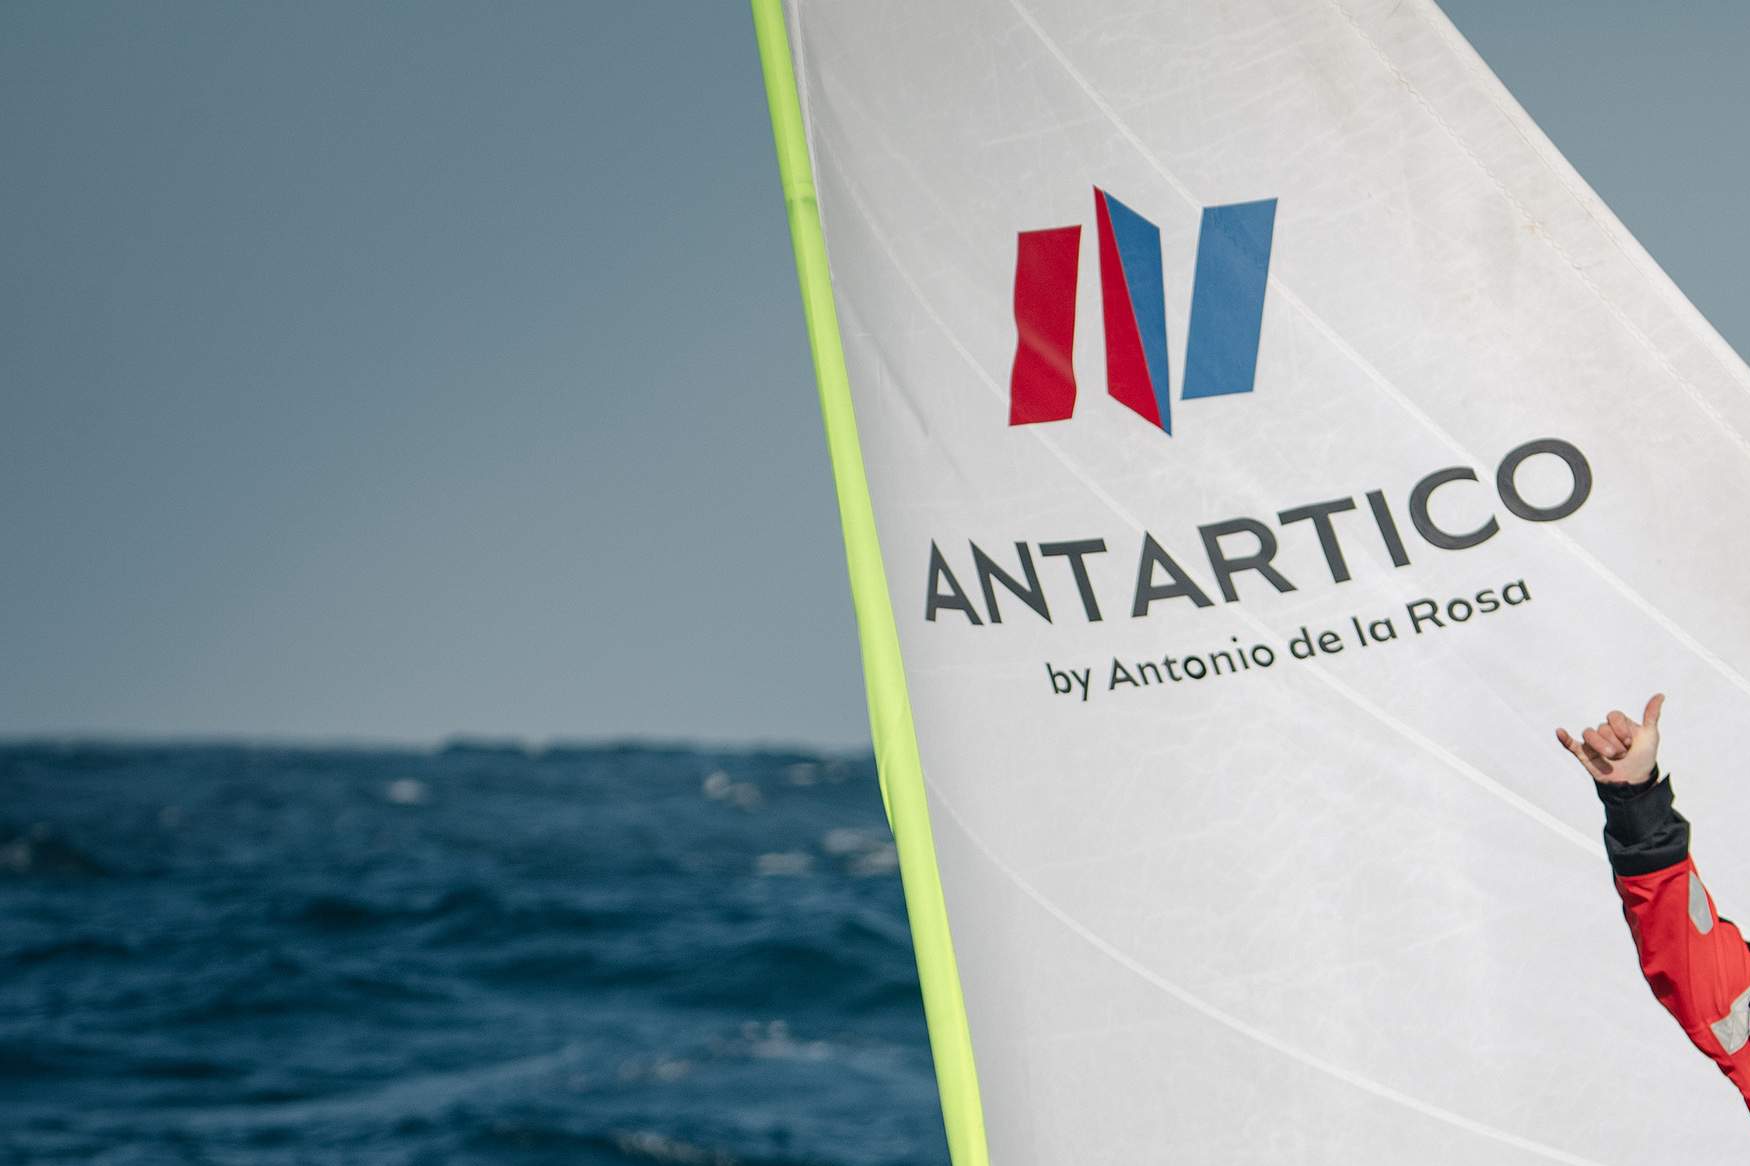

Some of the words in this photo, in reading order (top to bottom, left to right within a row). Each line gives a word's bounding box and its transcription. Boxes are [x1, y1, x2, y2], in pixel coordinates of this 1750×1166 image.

[924, 437, 1593, 626] ANTARTICO
[1045, 661, 1092, 702] by
[1108, 634, 1275, 692] Antonio
[1288, 625, 1344, 661] de
[1351, 615, 1398, 649] la
[1405, 577, 1532, 634] Rosa
